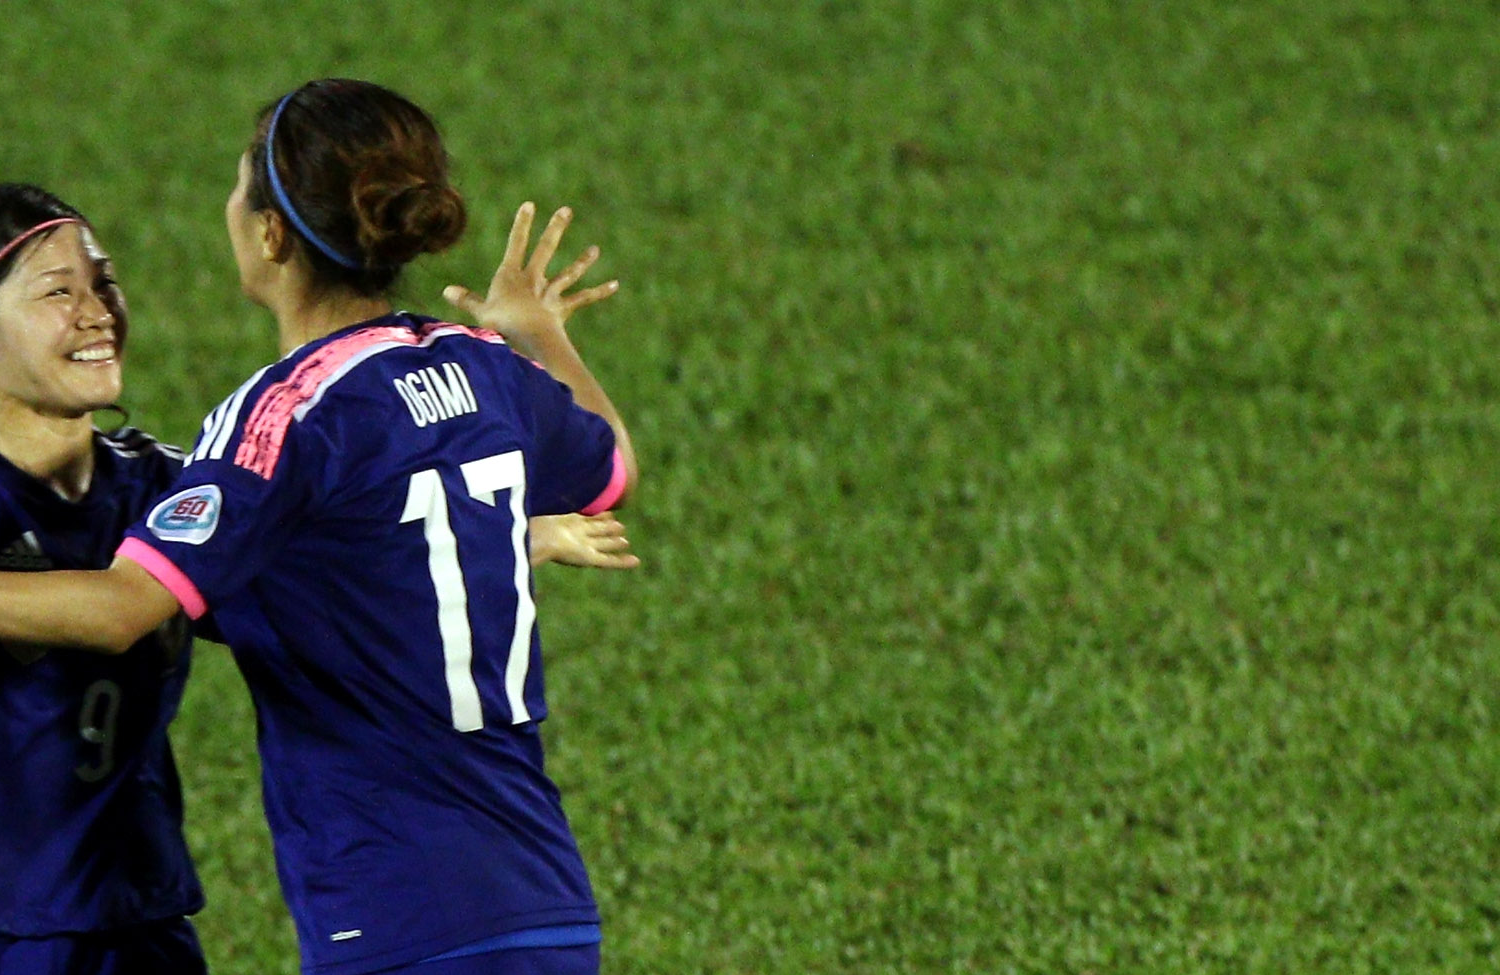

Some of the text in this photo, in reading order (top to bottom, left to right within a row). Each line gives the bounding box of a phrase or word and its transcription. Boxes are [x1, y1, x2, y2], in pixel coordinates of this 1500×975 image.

[393, 362, 478, 428] OGIMI
[173, 499, 208, 516] 60
[399, 450, 537, 732] 17
[75, 678, 121, 783] 9
